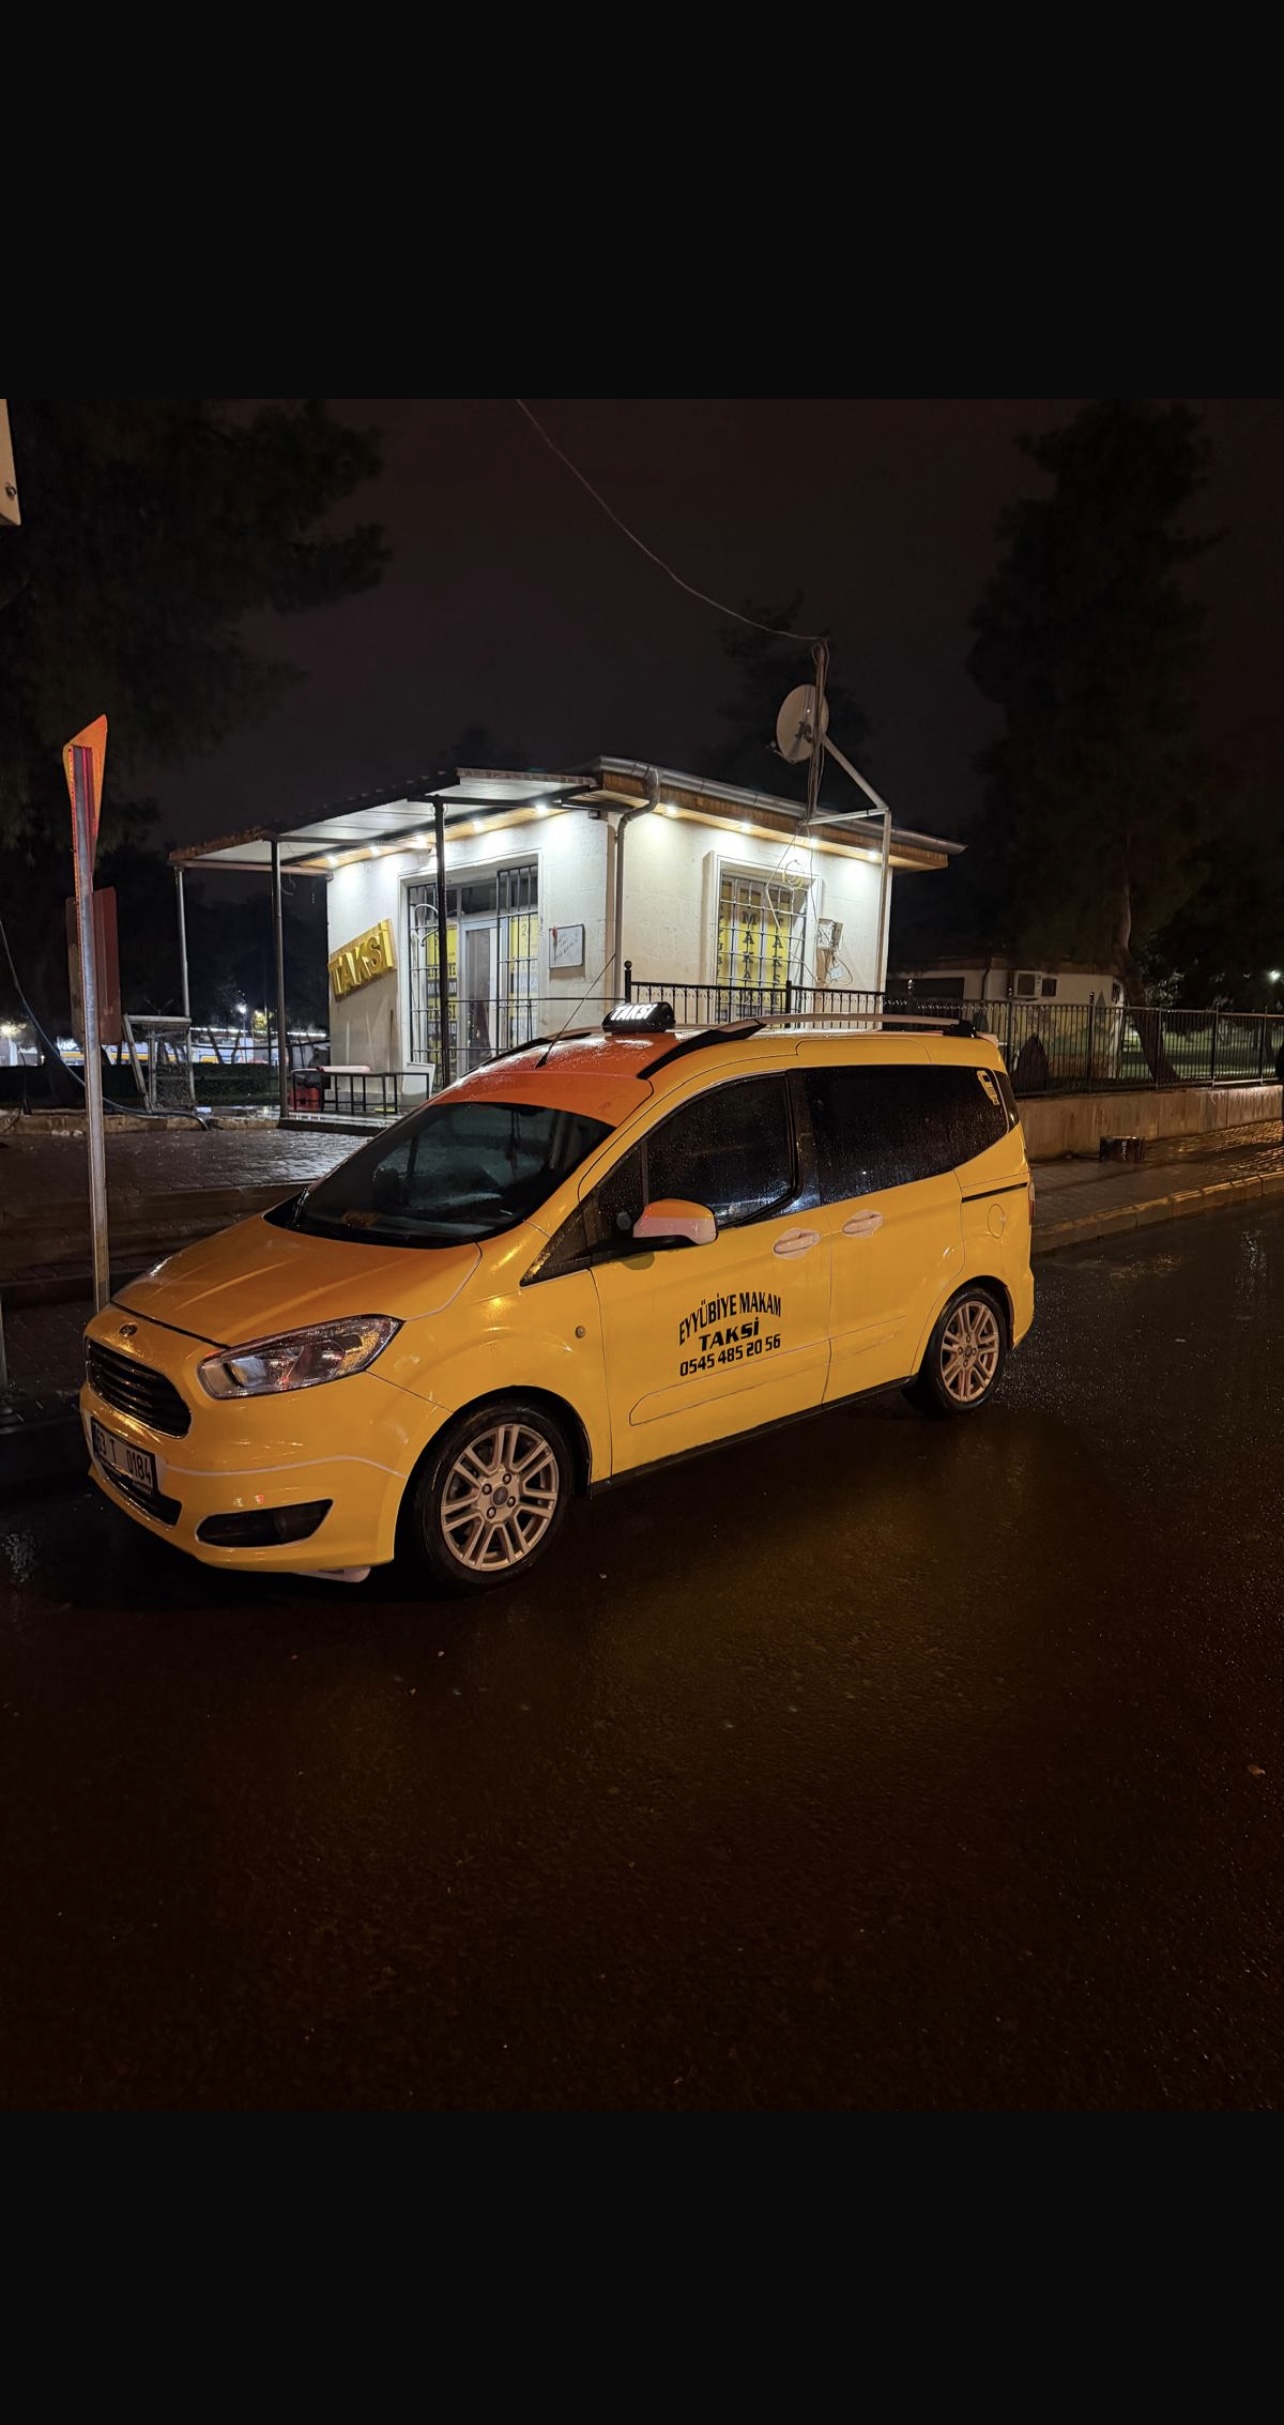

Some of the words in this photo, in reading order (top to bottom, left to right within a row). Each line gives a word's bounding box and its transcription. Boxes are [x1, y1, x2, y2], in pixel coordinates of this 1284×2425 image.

[328, 919, 394, 996] TAKSİ
[679, 1292, 737, 1346] EYYÜBİYE
[739, 1291, 782, 1318] MAKAM
[699, 1316, 760, 1352] TAKSİ
[680, 1353, 715, 1377] 0545
[717, 1345, 743, 1365] 485
[746, 1338, 763, 1357] 20
[765, 1333, 781, 1352] 56
[127, 1449, 152, 1484] 0184
